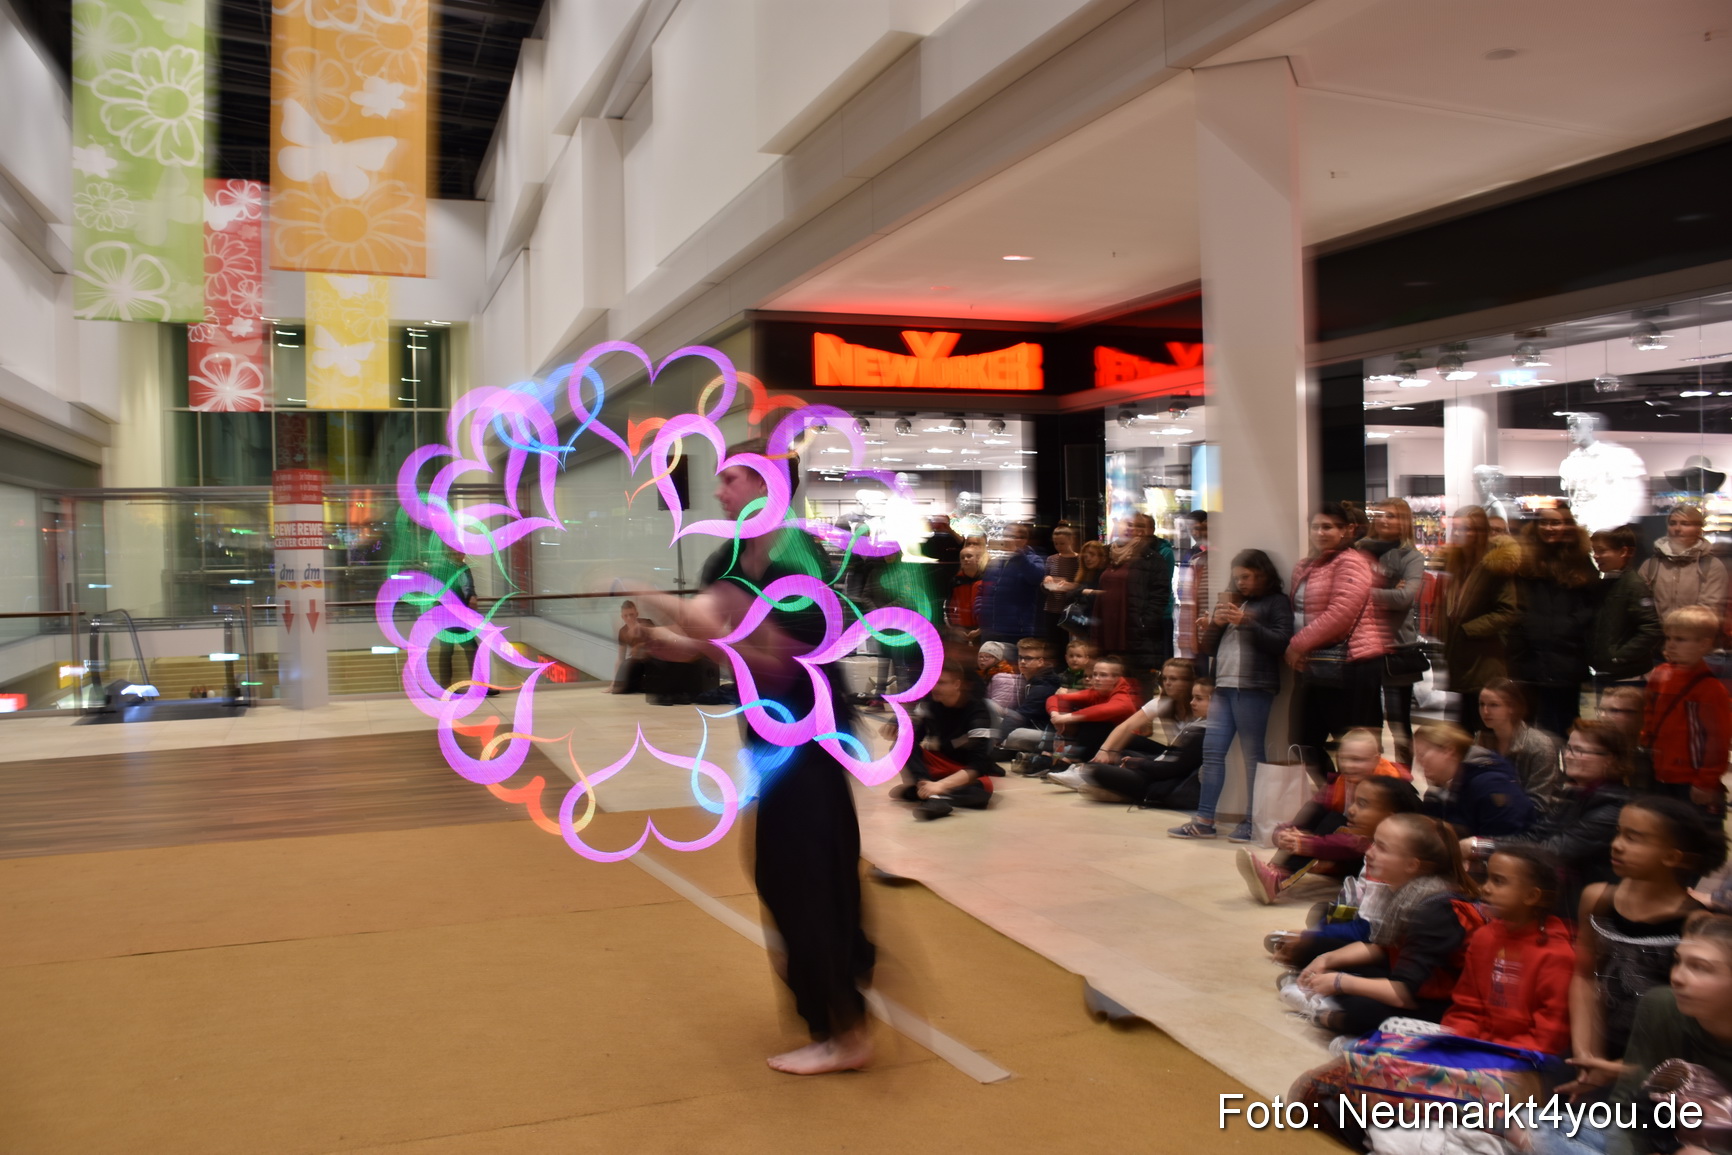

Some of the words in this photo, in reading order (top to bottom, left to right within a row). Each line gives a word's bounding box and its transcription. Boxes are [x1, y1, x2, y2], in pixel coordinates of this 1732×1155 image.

[297, 522, 323, 536] REWE
[298, 537, 323, 547] CENTER
[304, 563, 320, 580] dm
